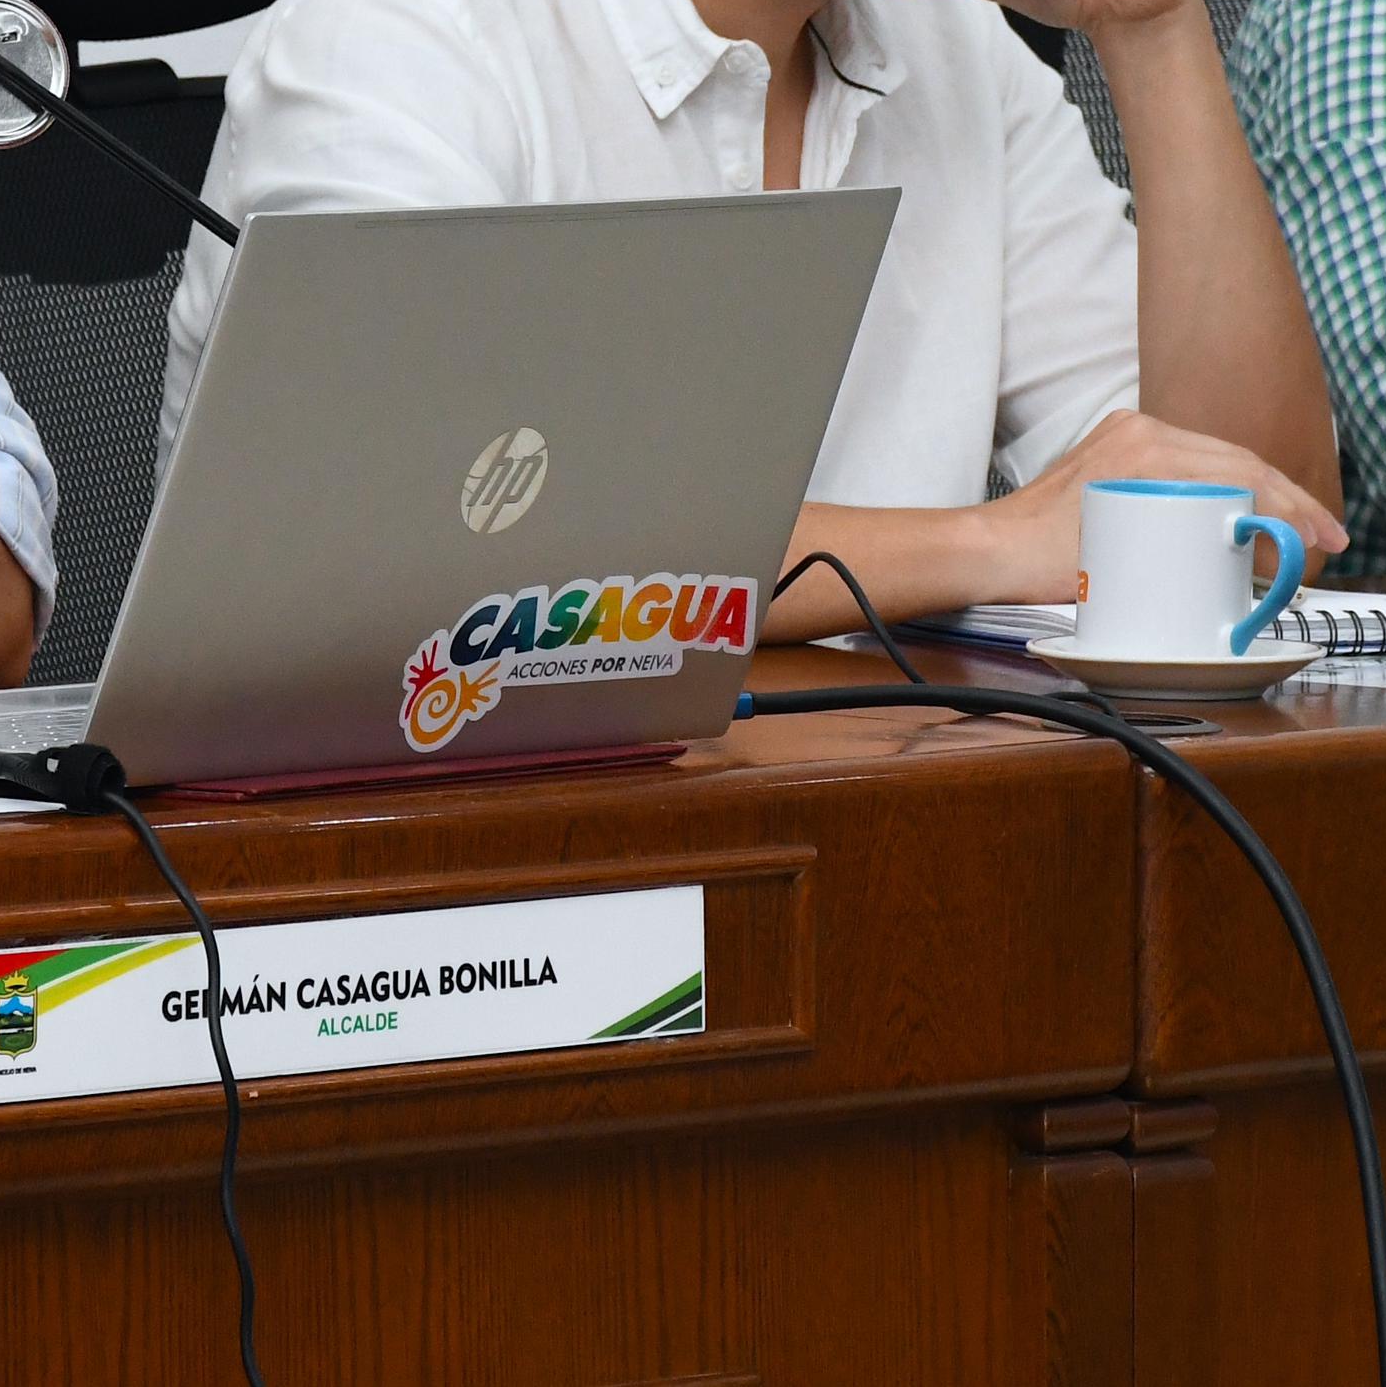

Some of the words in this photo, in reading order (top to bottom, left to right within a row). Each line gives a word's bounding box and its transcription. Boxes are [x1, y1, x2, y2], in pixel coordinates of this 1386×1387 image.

[449, 582, 748, 666] CASAGUA
[506, 659, 588, 680] ACCIONES
[590, 656, 626, 674] POR
[628, 653, 673, 672] NEIVA
[296, 968, 431, 1010] CASAGUA
[439, 955, 558, 996] BONILLA
[317, 1011, 398, 1037] ALCALDE
